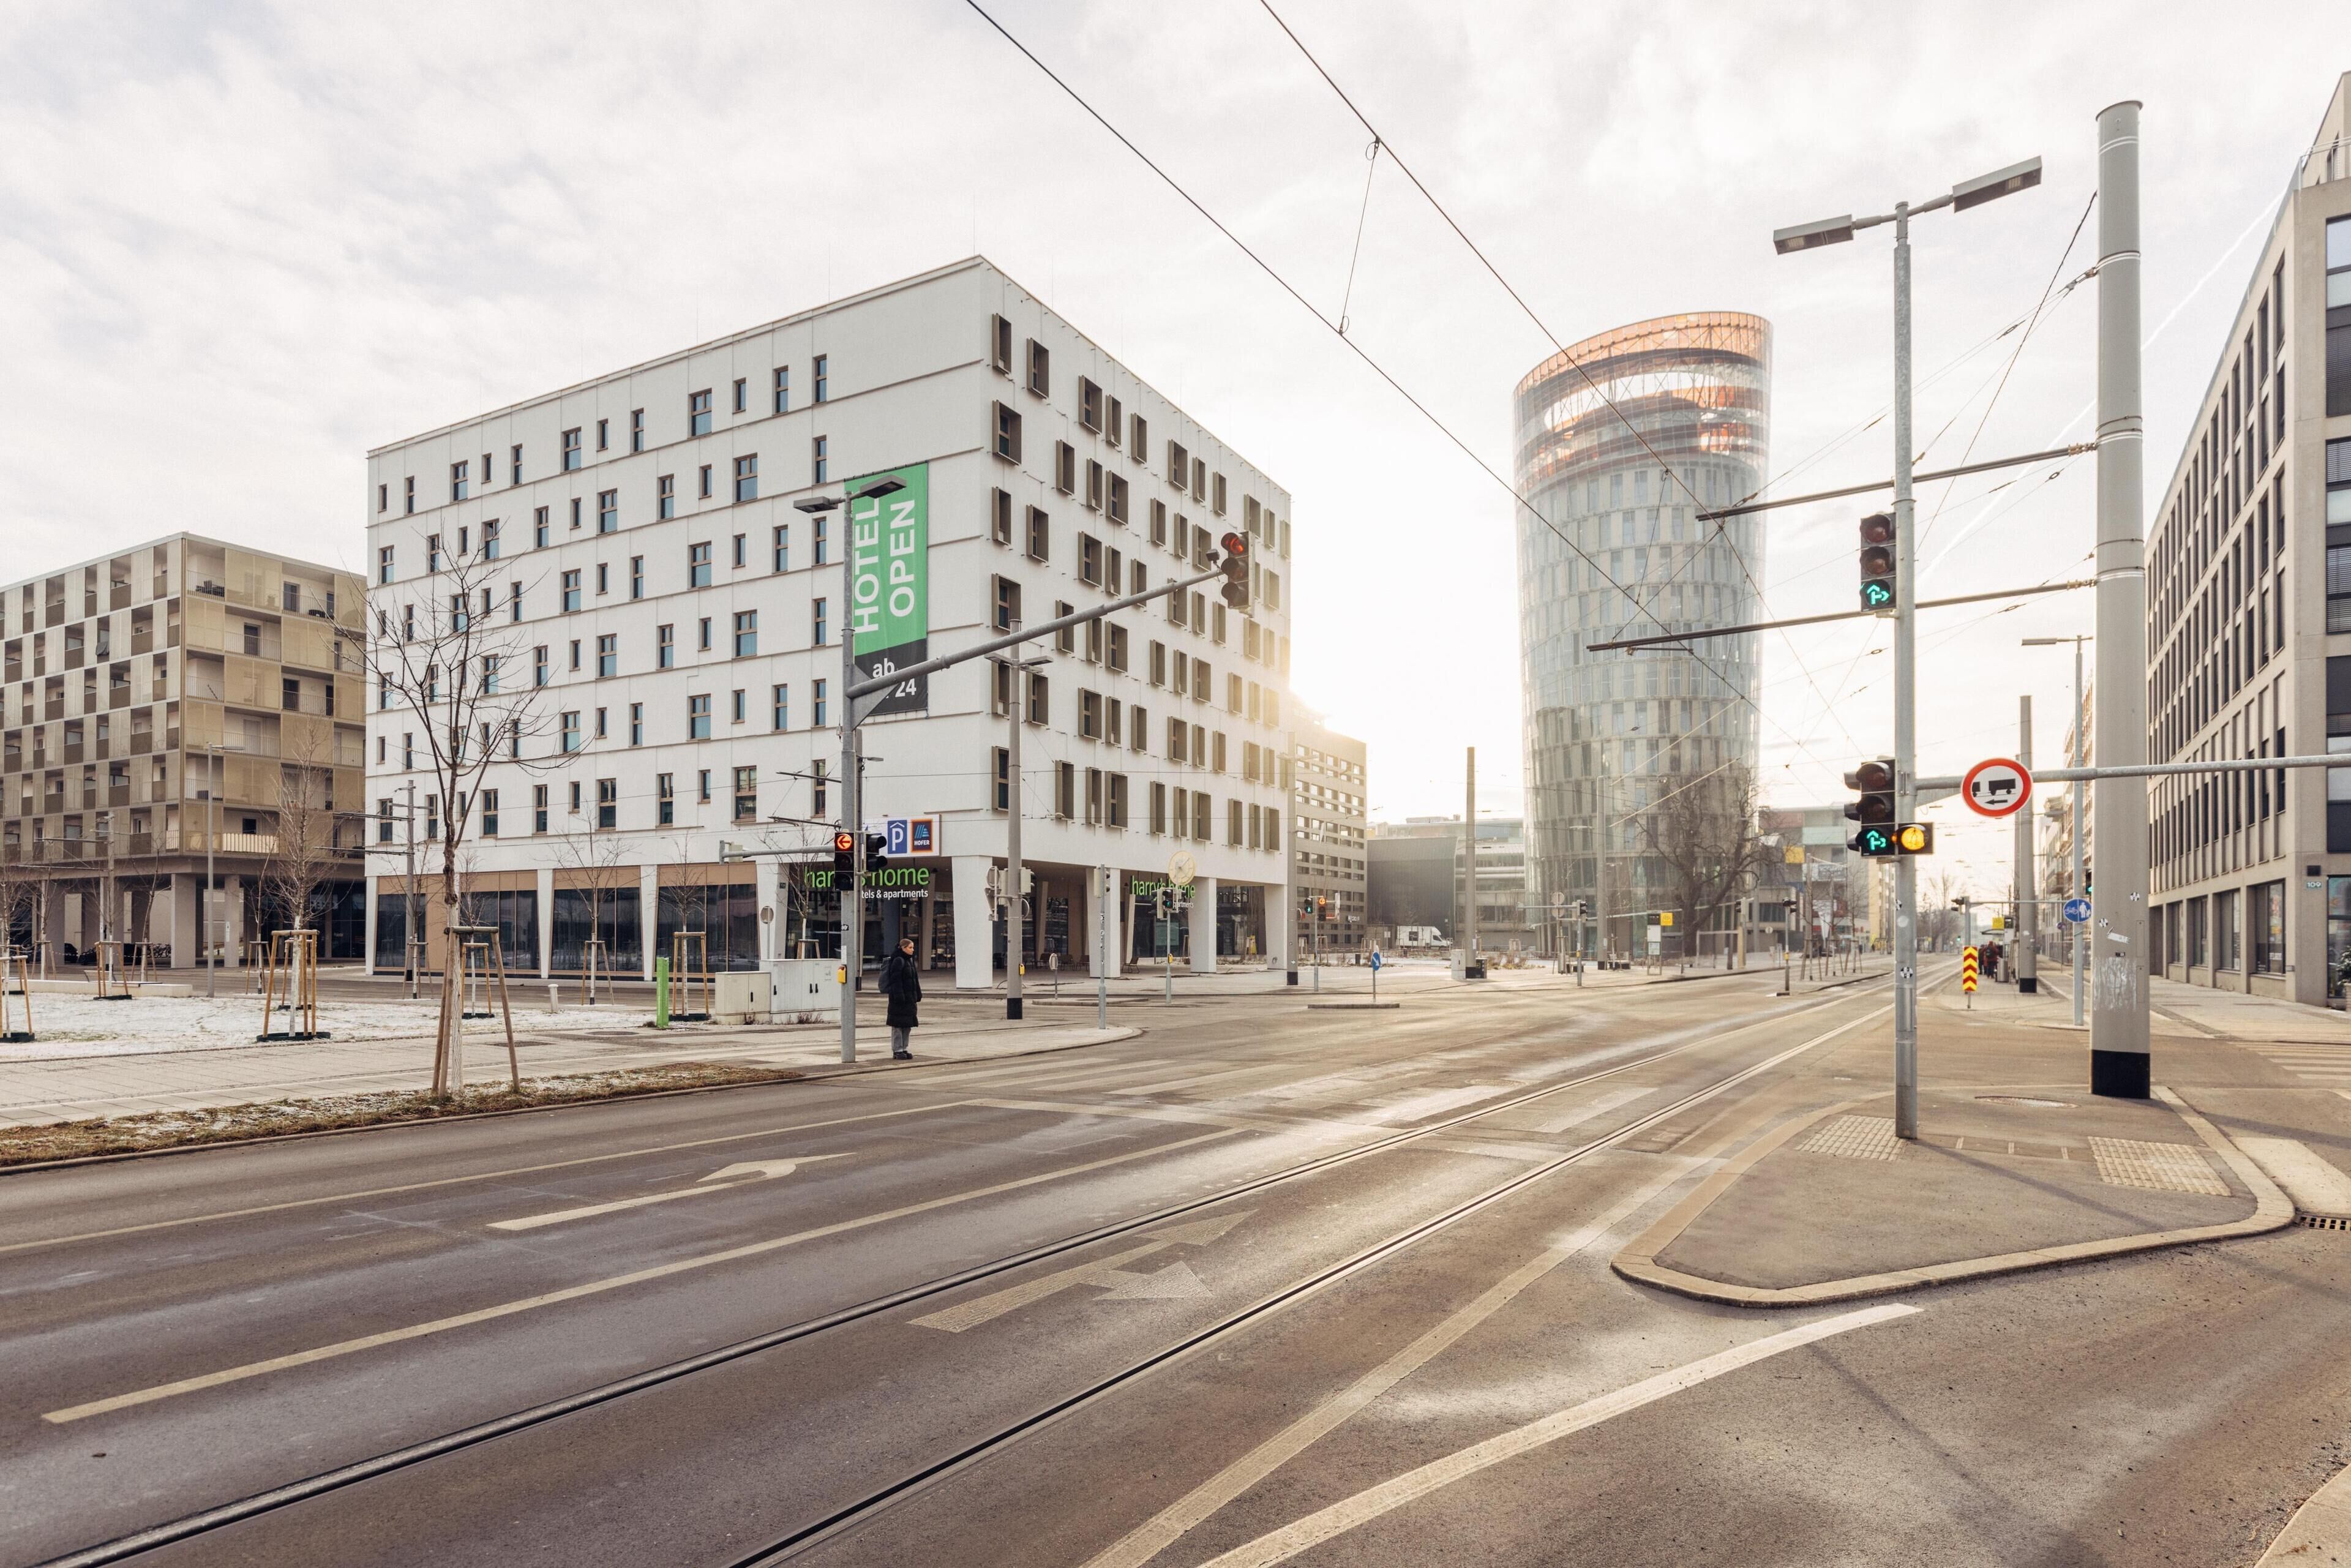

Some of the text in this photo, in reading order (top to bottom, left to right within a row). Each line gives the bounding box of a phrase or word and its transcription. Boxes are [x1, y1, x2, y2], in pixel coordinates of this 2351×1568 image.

[854, 498, 879, 634] HOTEL
[889, 500, 915, 618] OPEN
[872, 658, 895, 678] ab
[876, 890, 882, 899] &
[883, 888, 929, 901] apartments
